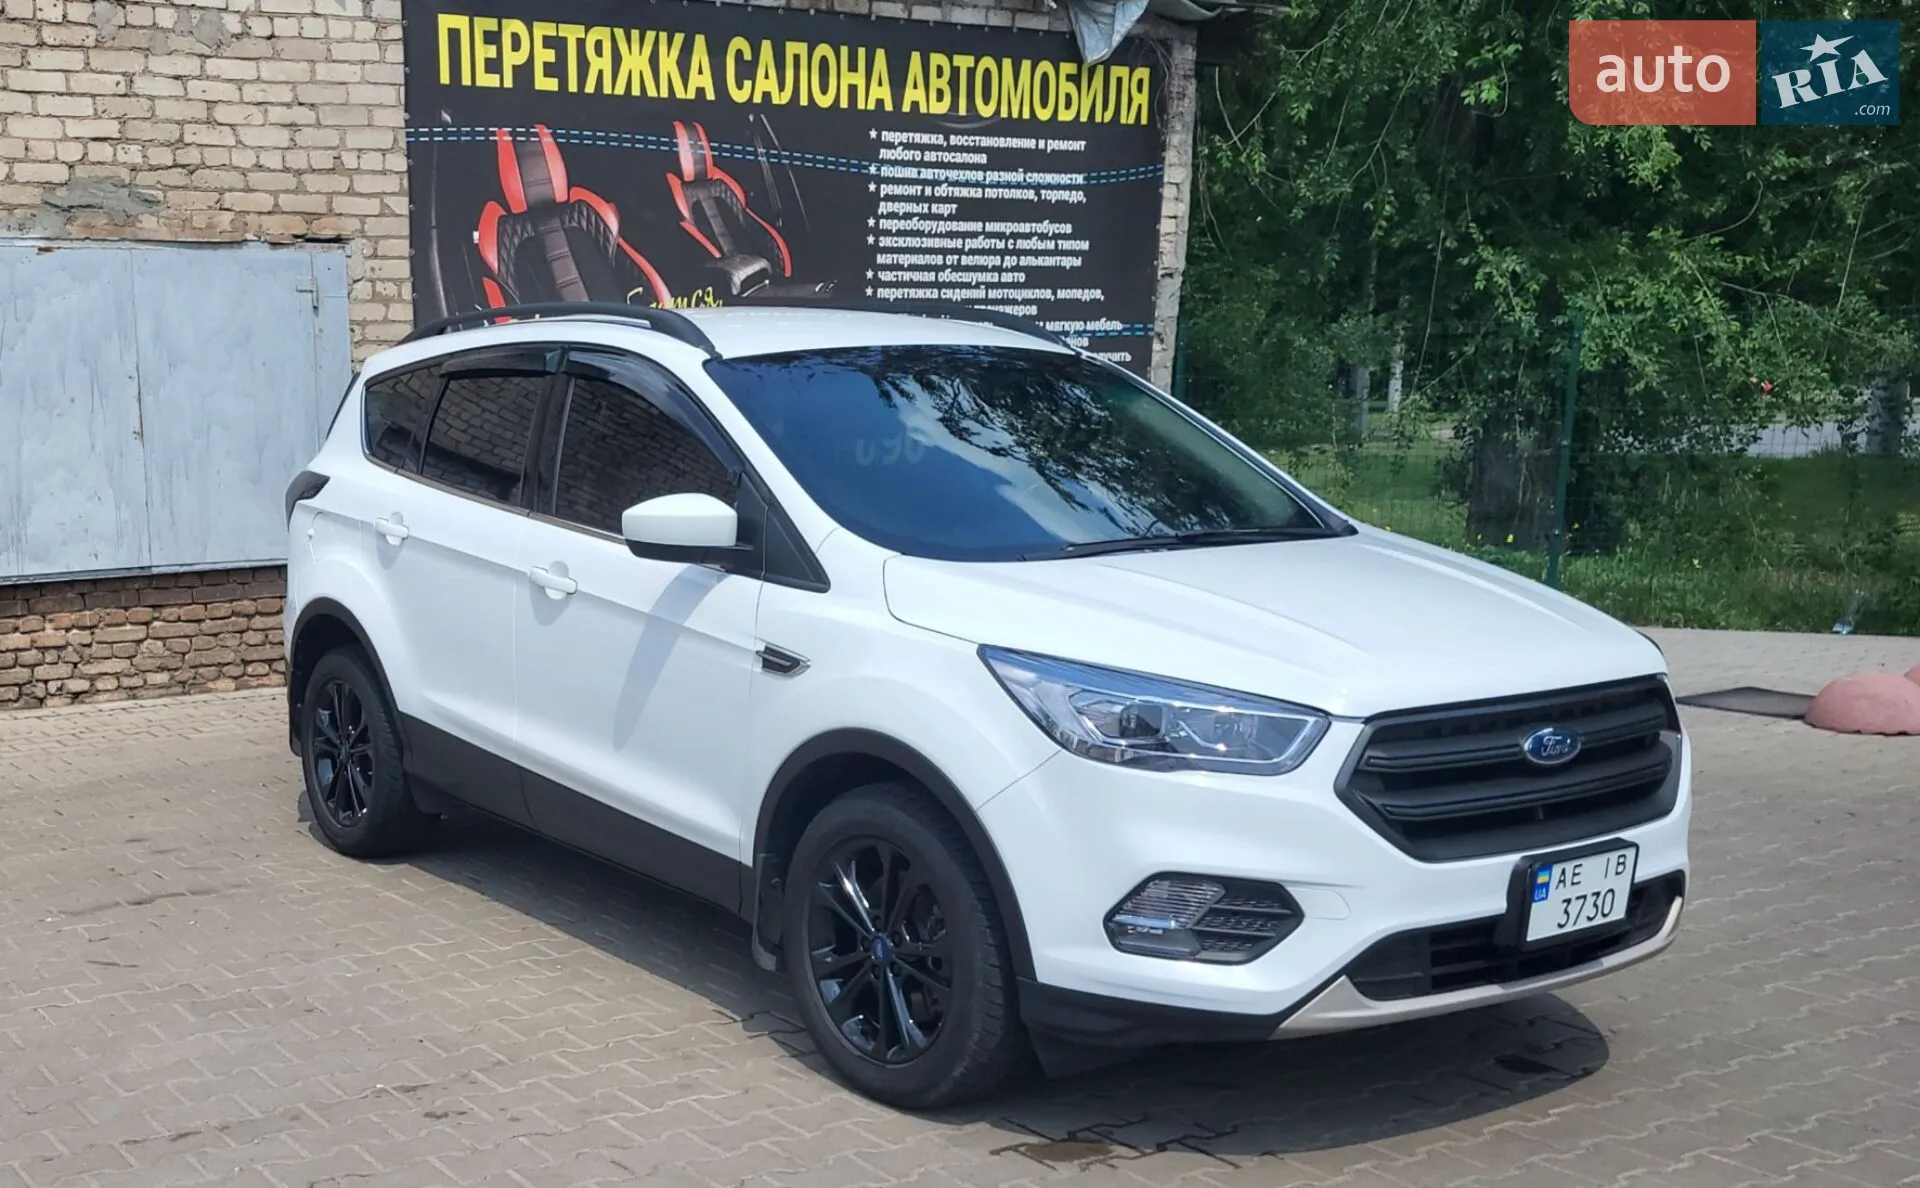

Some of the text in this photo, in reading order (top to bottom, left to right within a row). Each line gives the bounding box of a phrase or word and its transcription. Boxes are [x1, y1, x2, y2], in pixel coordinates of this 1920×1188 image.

[437, 13, 1151, 125] ПЕРЕТЯЖКА САЛОНА АВТОМОБИЛЯ
[881, 129, 1086, 153] перетяжка, восстановление и ремонт
[879, 145, 987, 165] любого автосалона
[881, 166, 919, 179] пошив
[920, 168, 984, 183] авточехлов
[986, 168, 1024, 186] разной
[880, 183, 1087, 203] ремонт и обтяжка потолков, торпедо,
[878, 201, 957, 217] дверных карт
[879, 217, 1072, 235] переоборудование микроавтобусов
[878, 236, 1089, 252] эксклюзивные работы с любым типом
[877, 254, 1082, 270] материалов от велюра до алькантары
[878, 269, 1025, 285] частичная обесшумка авто
[877, 285, 1104, 303] перетяжка сидений мотоциклов, мопедов,
[1045, 320, 1084, 333] мягкую
[1086, 317, 1122, 331] мебель
[1541, 735, 1572, 756] Ford
[1556, 854, 1627, 890] AE IB
[1534, 888, 1547, 900] UA
[1556, 888, 1615, 929] 3730
